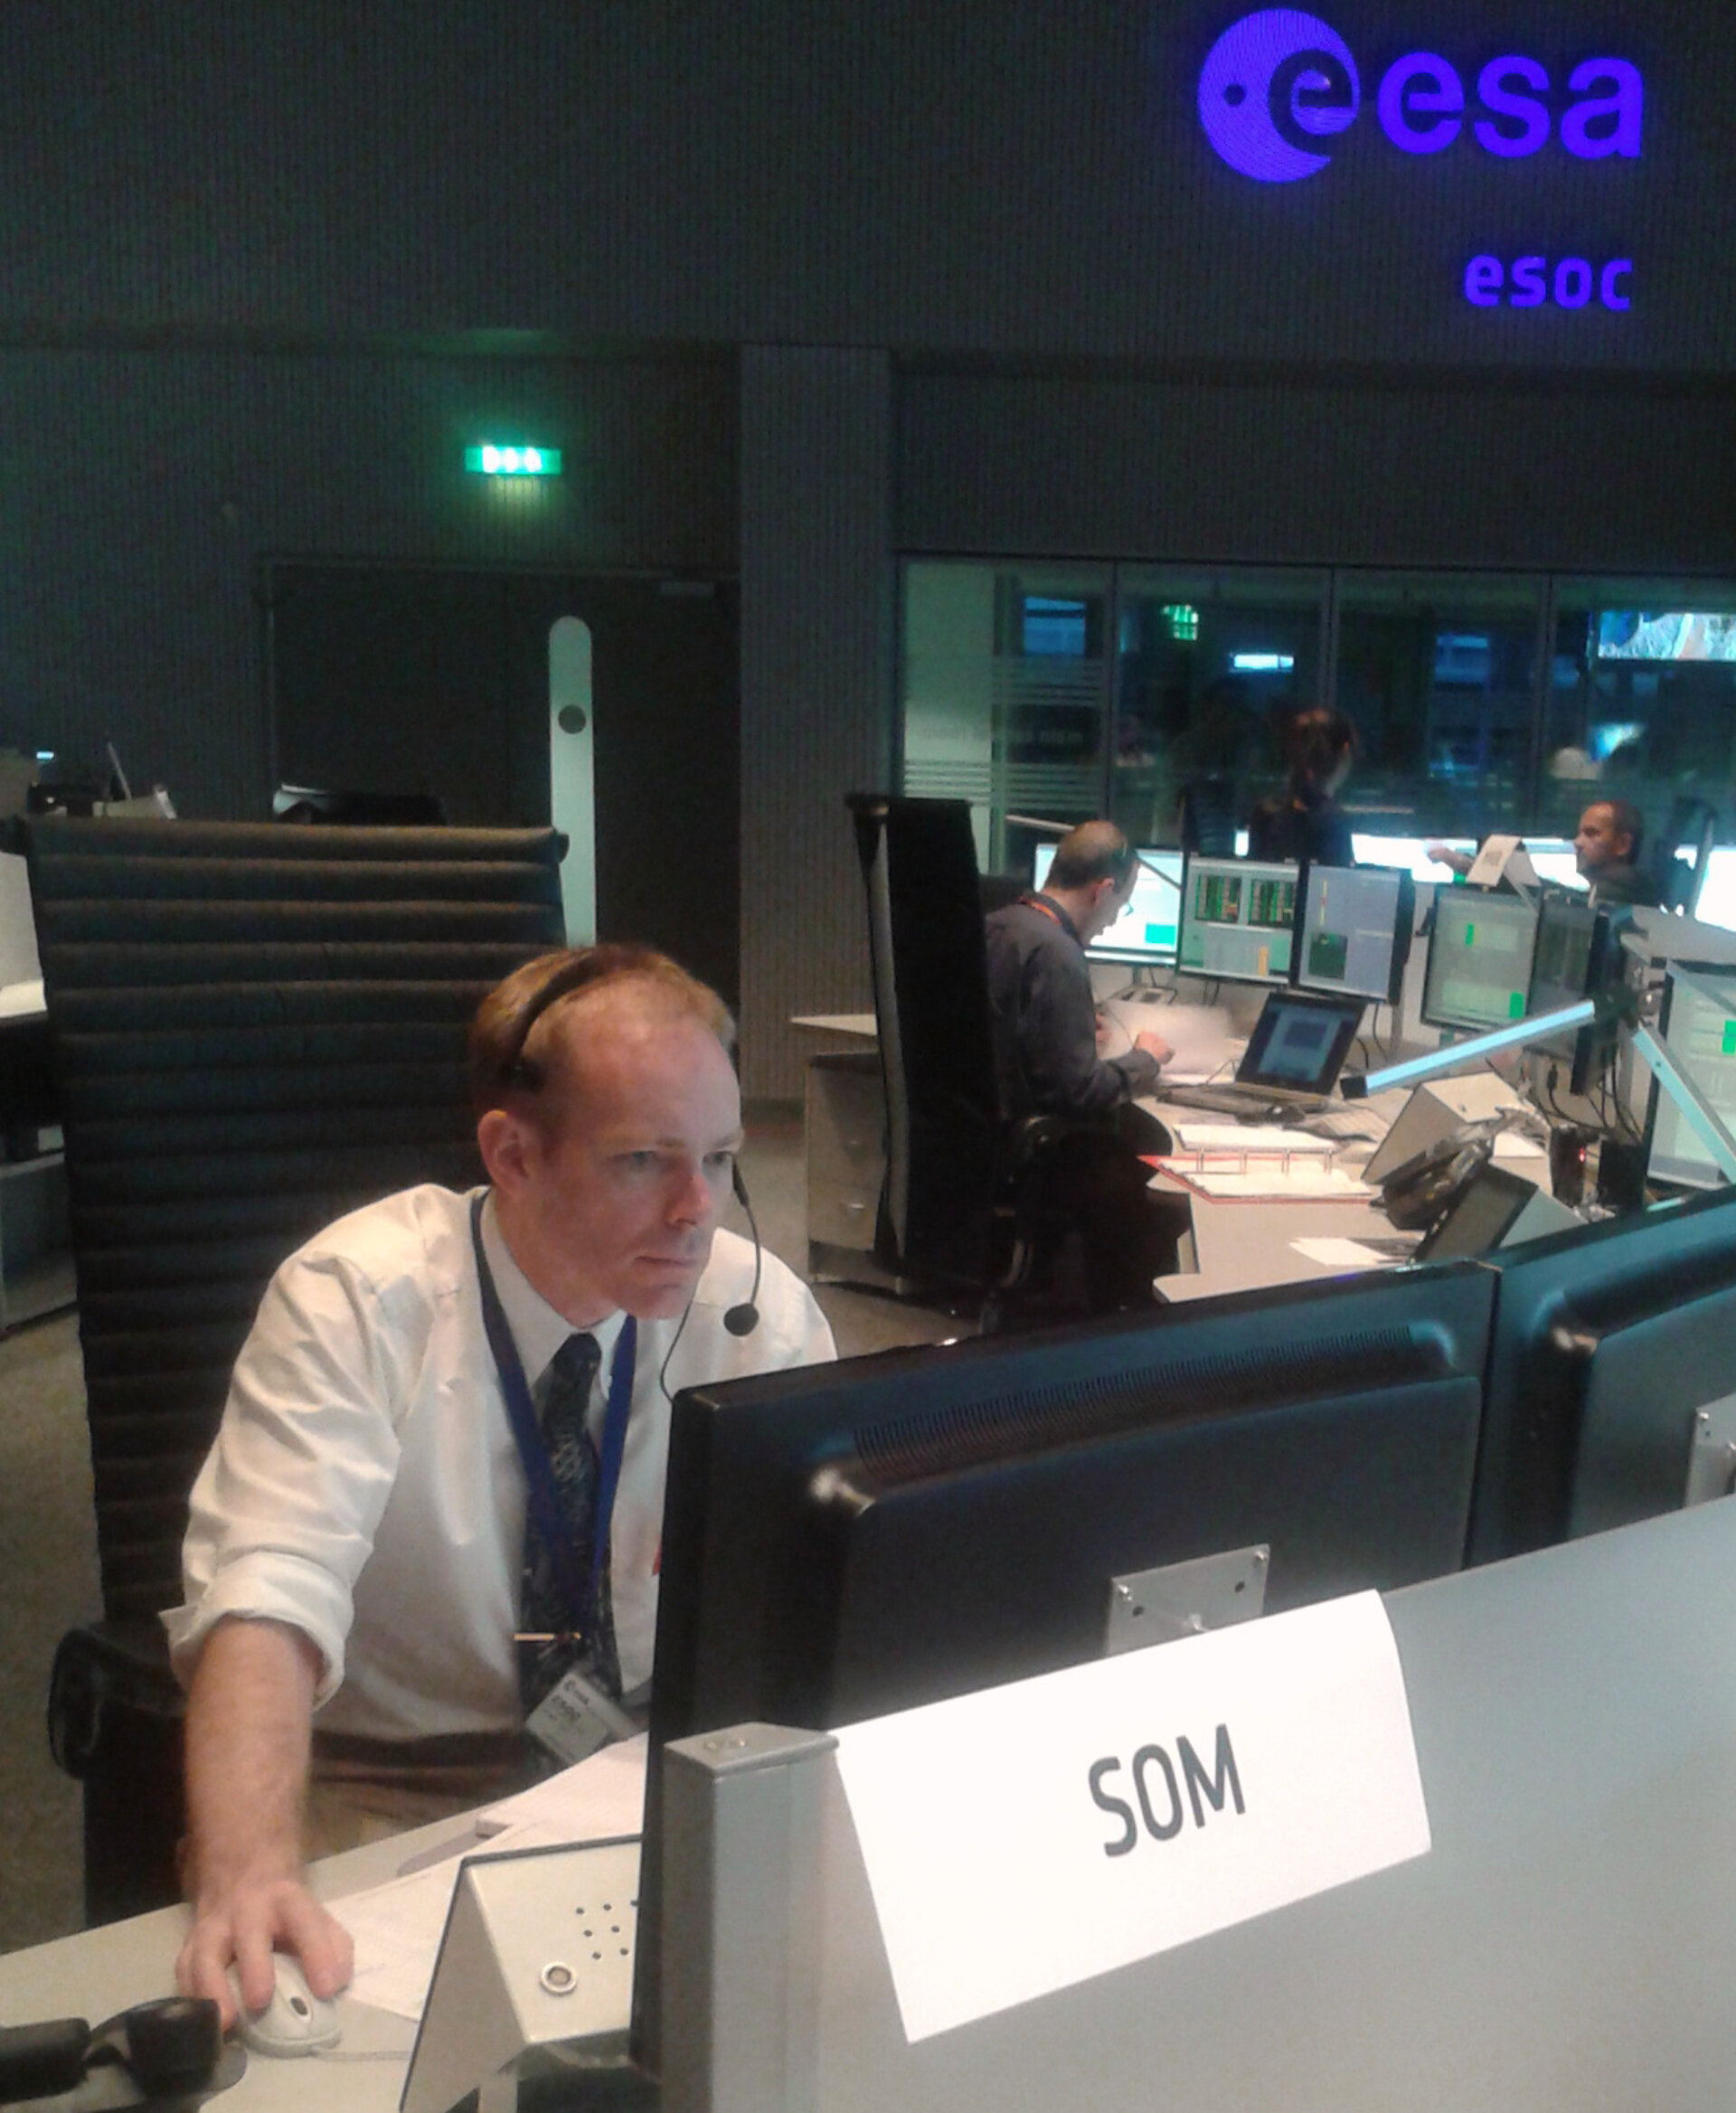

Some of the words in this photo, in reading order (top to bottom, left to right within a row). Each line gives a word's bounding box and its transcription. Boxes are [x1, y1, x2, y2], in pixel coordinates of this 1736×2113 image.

[1376, 51, 1644, 160] esa
[1464, 254, 1632, 311] esoc
[1089, 1724, 1245, 1857] SOM
